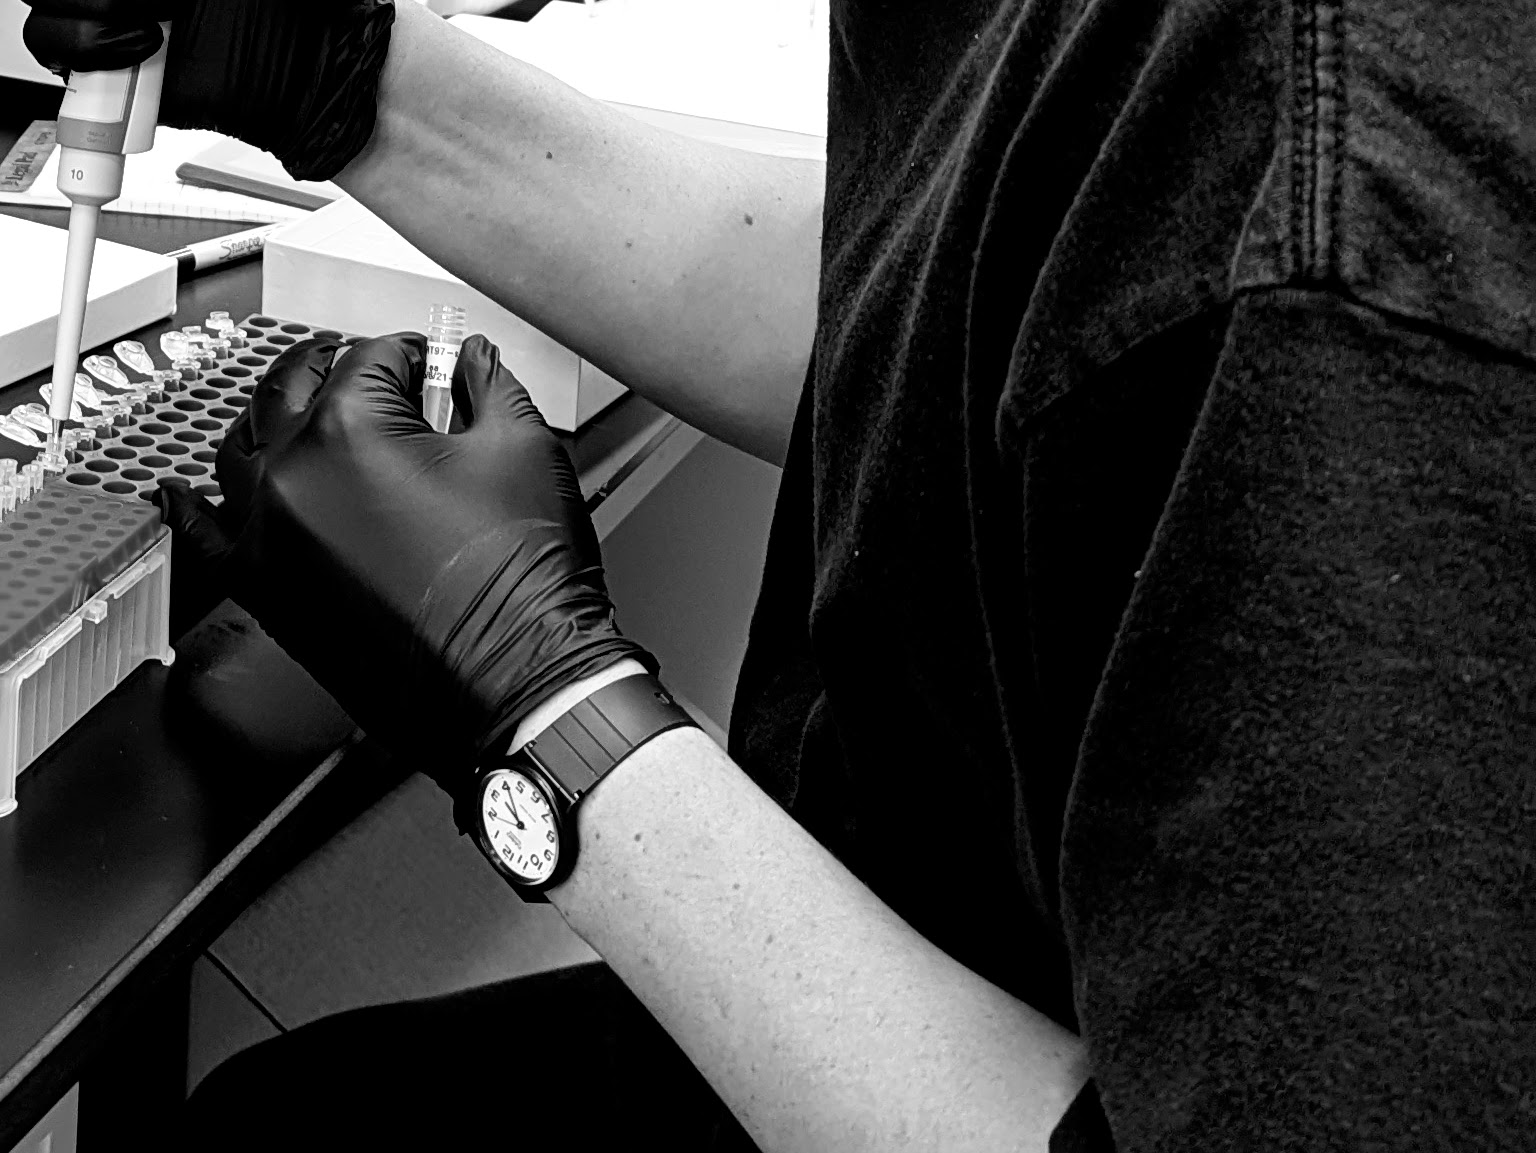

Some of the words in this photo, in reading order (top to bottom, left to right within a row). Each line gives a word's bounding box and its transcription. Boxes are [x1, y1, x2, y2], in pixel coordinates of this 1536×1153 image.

[70, 169, 84, 181] 10
[502, 844, 515, 862] 12
[530, 853, 544, 871] 10
